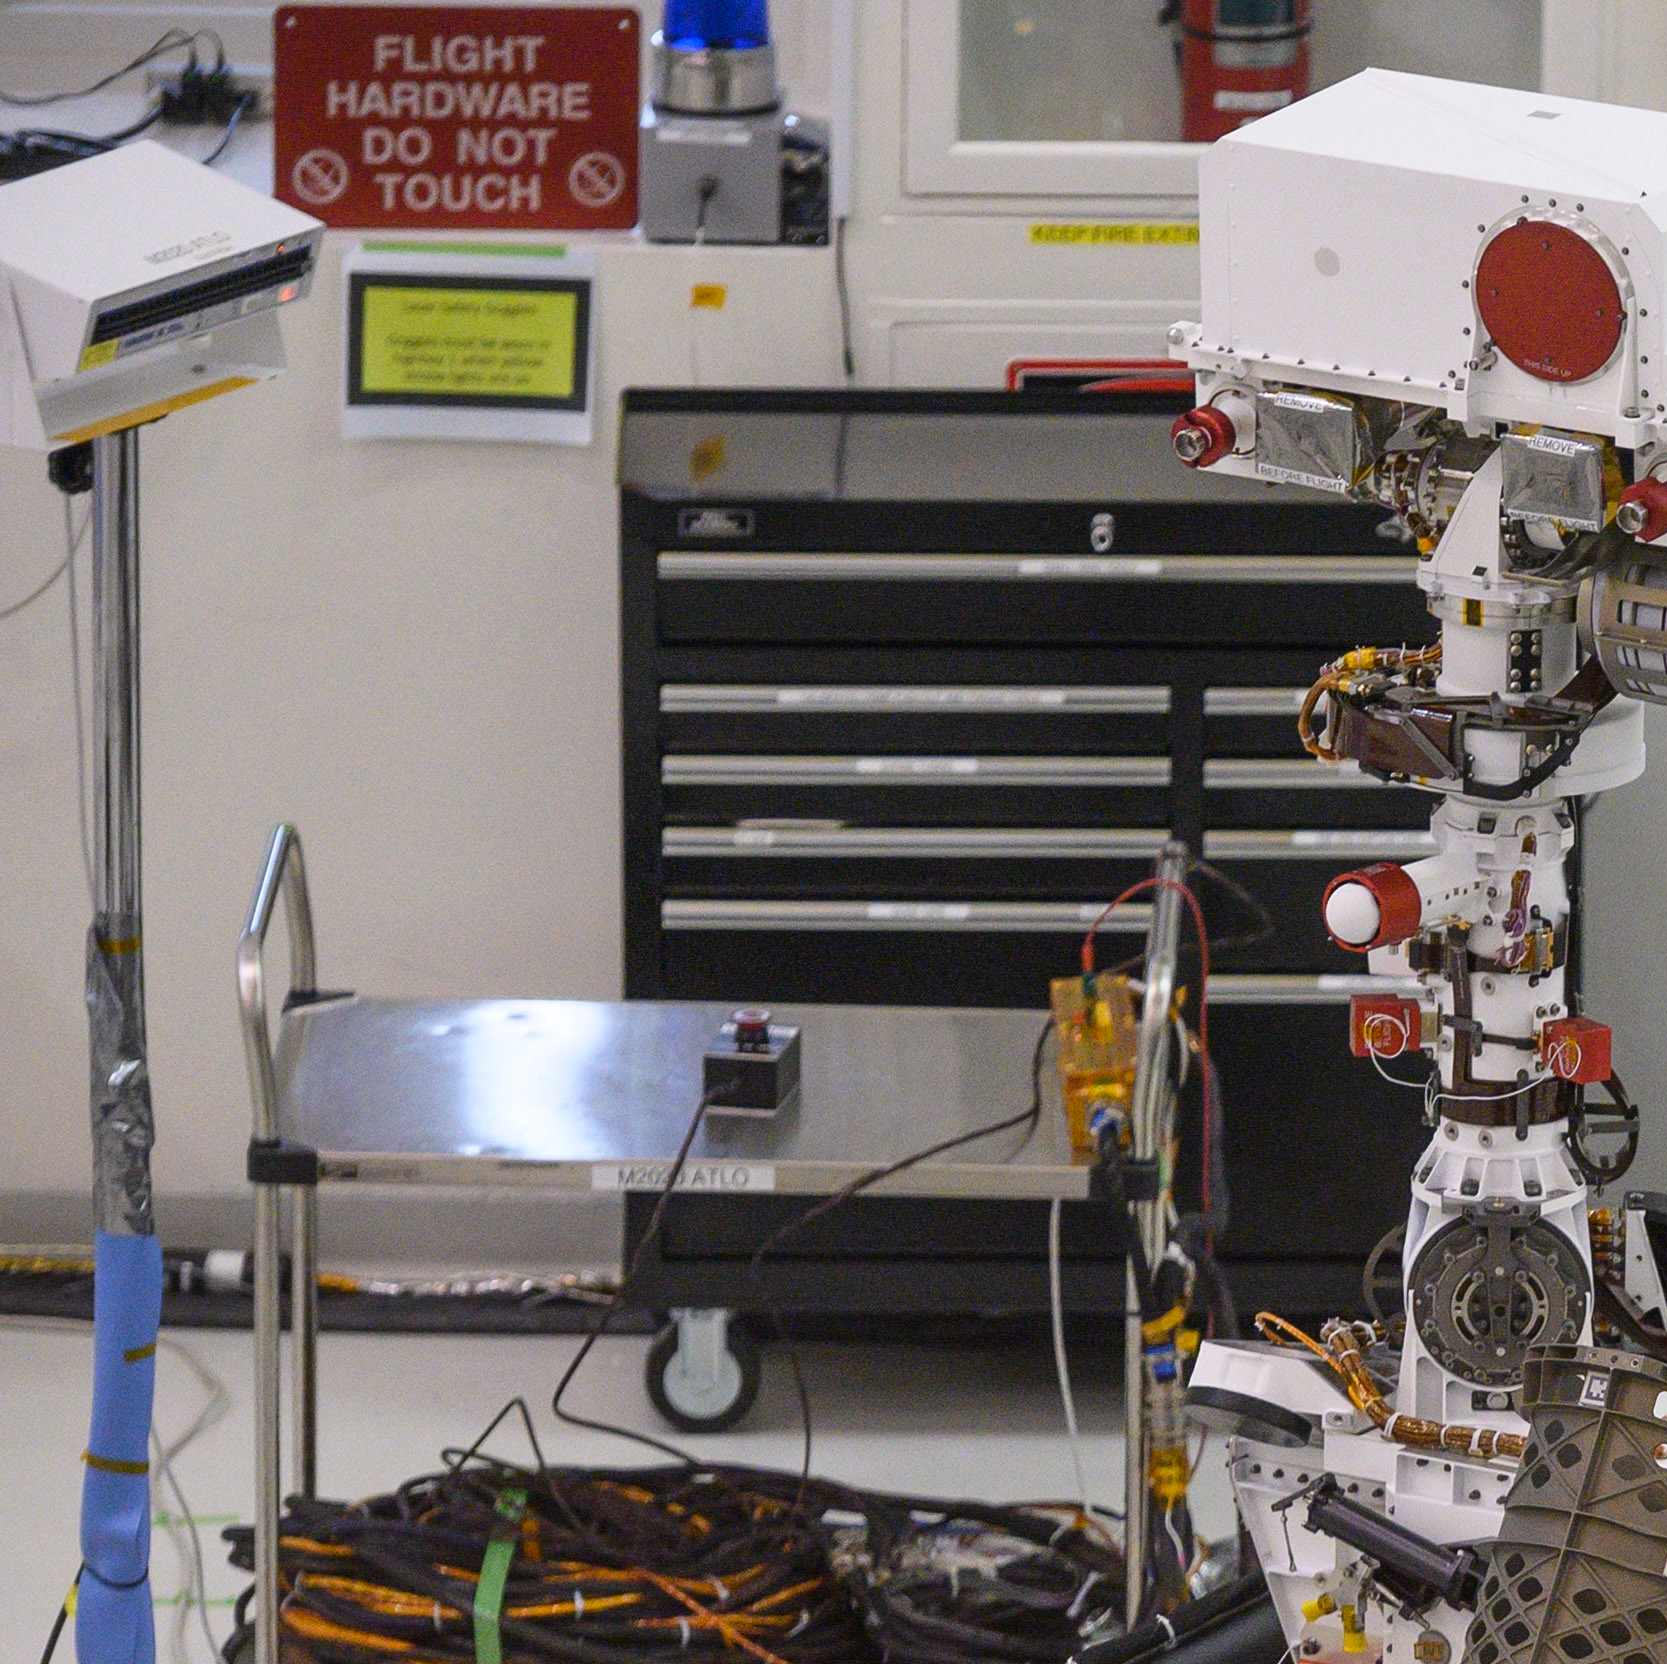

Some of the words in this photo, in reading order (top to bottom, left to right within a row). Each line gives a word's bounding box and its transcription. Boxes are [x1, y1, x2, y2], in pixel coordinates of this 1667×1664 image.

[373, 34, 545, 73] FLIGHT
[325, 79, 593, 120] HARDWARE
[361, 126, 432, 166] DO
[456, 126, 558, 166] NOT
[373, 171, 542, 212] TOUCH
[1092, 226, 1139, 242] FIRE
[1560, 368, 1572, 378] UP
[1276, 394, 1323, 411] REMOVE
[1529, 436, 1574, 454] REMOVE
[1260, 465, 1303, 483] BEFORE
[1306, 475, 1343, 490] FLIGHT
[691, 1167, 750, 1186] ATLO
